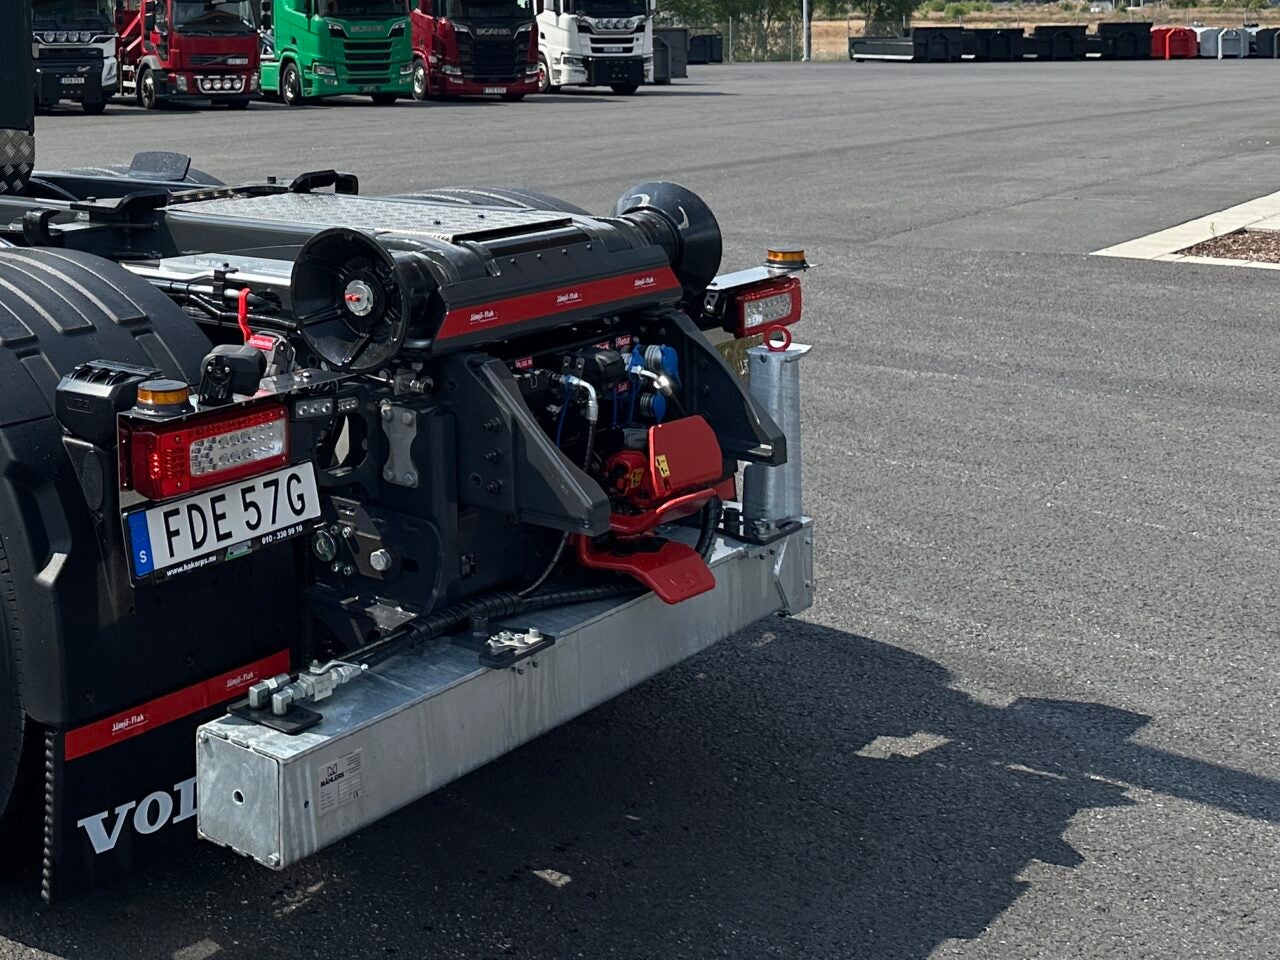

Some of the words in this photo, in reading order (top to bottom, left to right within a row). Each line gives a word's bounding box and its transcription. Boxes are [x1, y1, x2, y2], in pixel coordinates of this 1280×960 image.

[475, 27, 512, 36] SCANIA
[162, 493, 233, 559] FDE
[240, 472, 307, 532] 57G
[295, 524, 304, 533] 10
[139, 549, 149, 564] S
